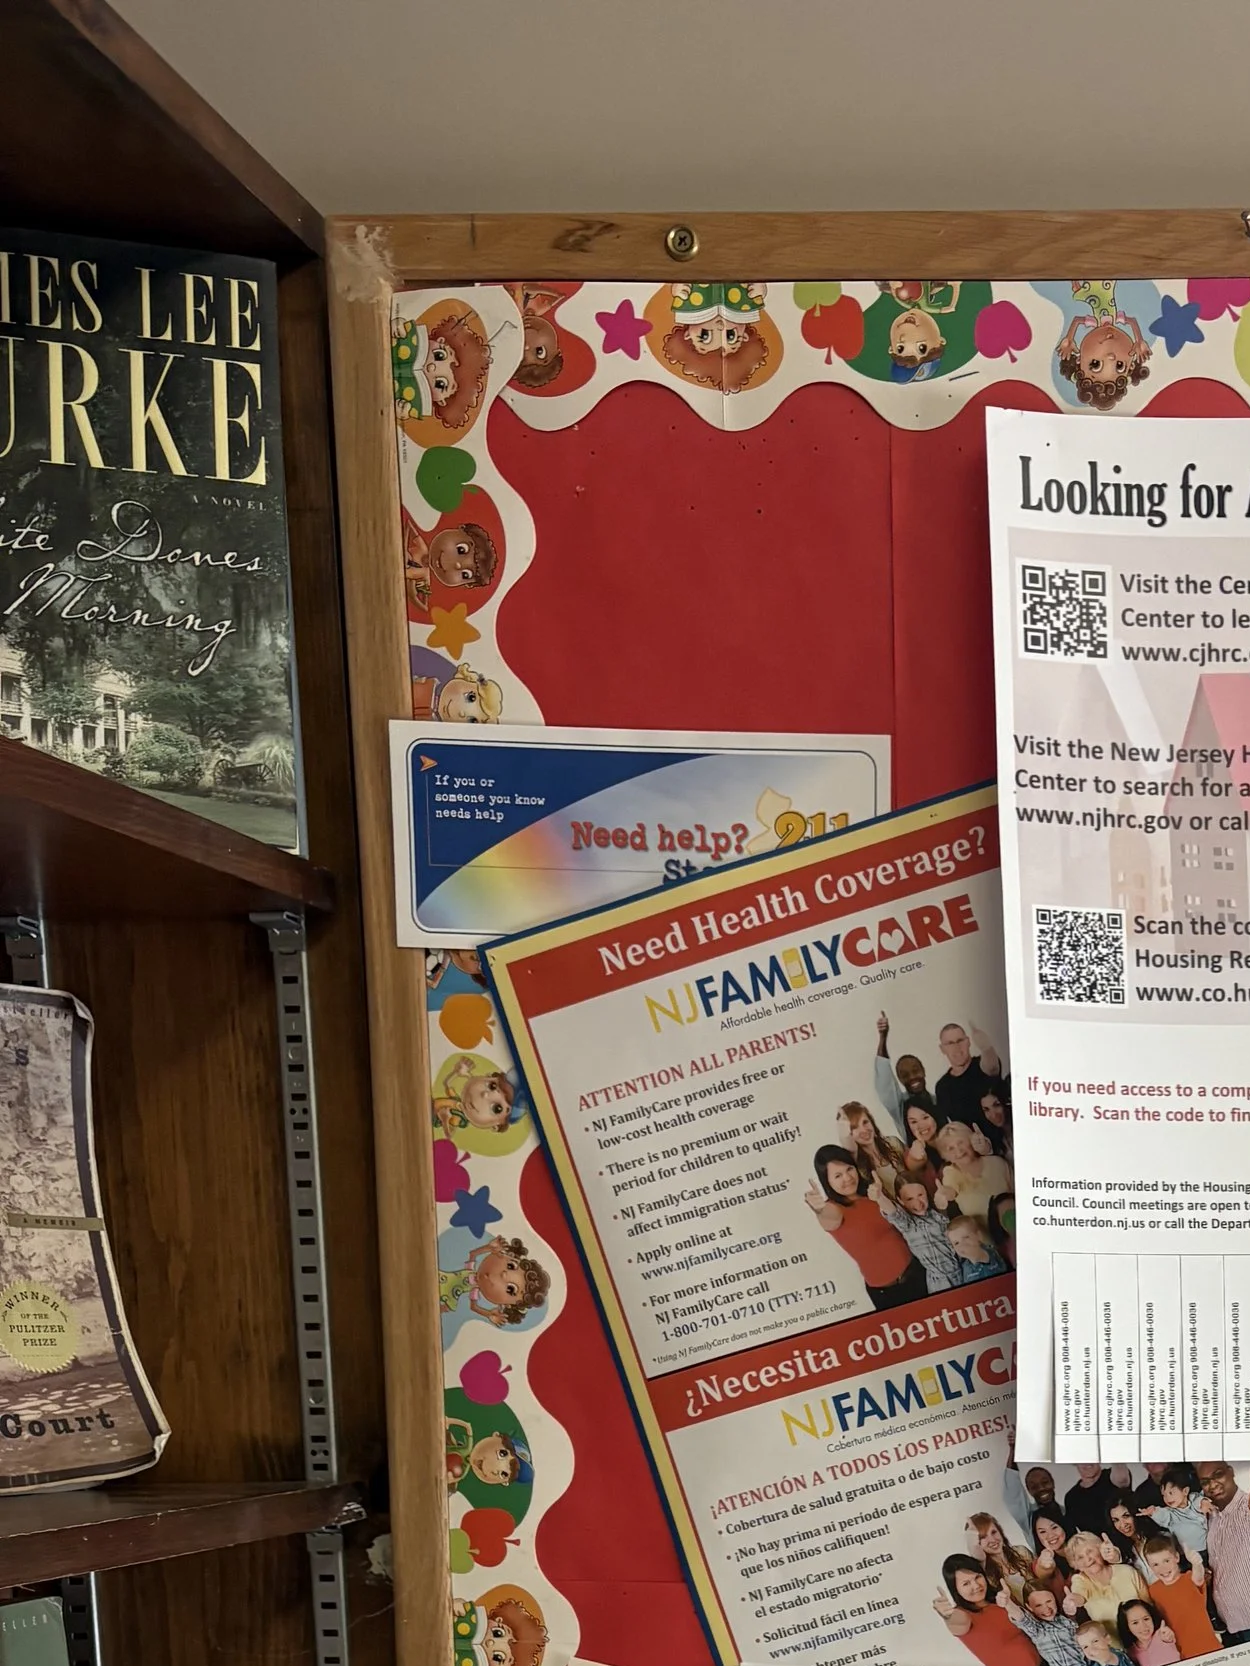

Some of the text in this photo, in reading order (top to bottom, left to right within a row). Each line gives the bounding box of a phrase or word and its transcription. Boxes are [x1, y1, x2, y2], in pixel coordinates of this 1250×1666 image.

[135, 267, 261, 351] LEE
[0, 336, 267, 486] RKE
[1018, 455, 1168, 528] Looking
[1179, 462, 1233, 519] for
[77, 500, 263, 572] Doves
[1119, 573, 1169, 594] Visit
[1174, 574, 1212, 595] the
[3, 562, 237, 677] Morning
[434, 774, 495, 789] If you or
[434, 793, 546, 807] someone you know
[435, 807, 505, 823] needs help
[569, 820, 749, 859] Need help?
[597, 826, 985, 976] Need Health Coverage?
[579, 1022, 817, 1112] ATTENTION ALL PARENTS!
[1148, 1220, 1162, 1229] or
[1164, 1217, 1185, 1229] call
[1187, 1217, 1208, 1229] the
[640, 1231, 783, 1281] www.njfamilycare.org
[4, 1290, 61, 1312] WINNER
[33, 1312, 50, 1320] THE
[662, 1280, 837, 1342] 1-800-701-0710 (TTY: 711)
[9, 1324, 66, 1334] PULITZER
[22, 1337, 58, 1347] PRIZE
[686, 1296, 1014, 1417] ¿Necesita cobertura
[0, 1407, 115, 1439] Court
